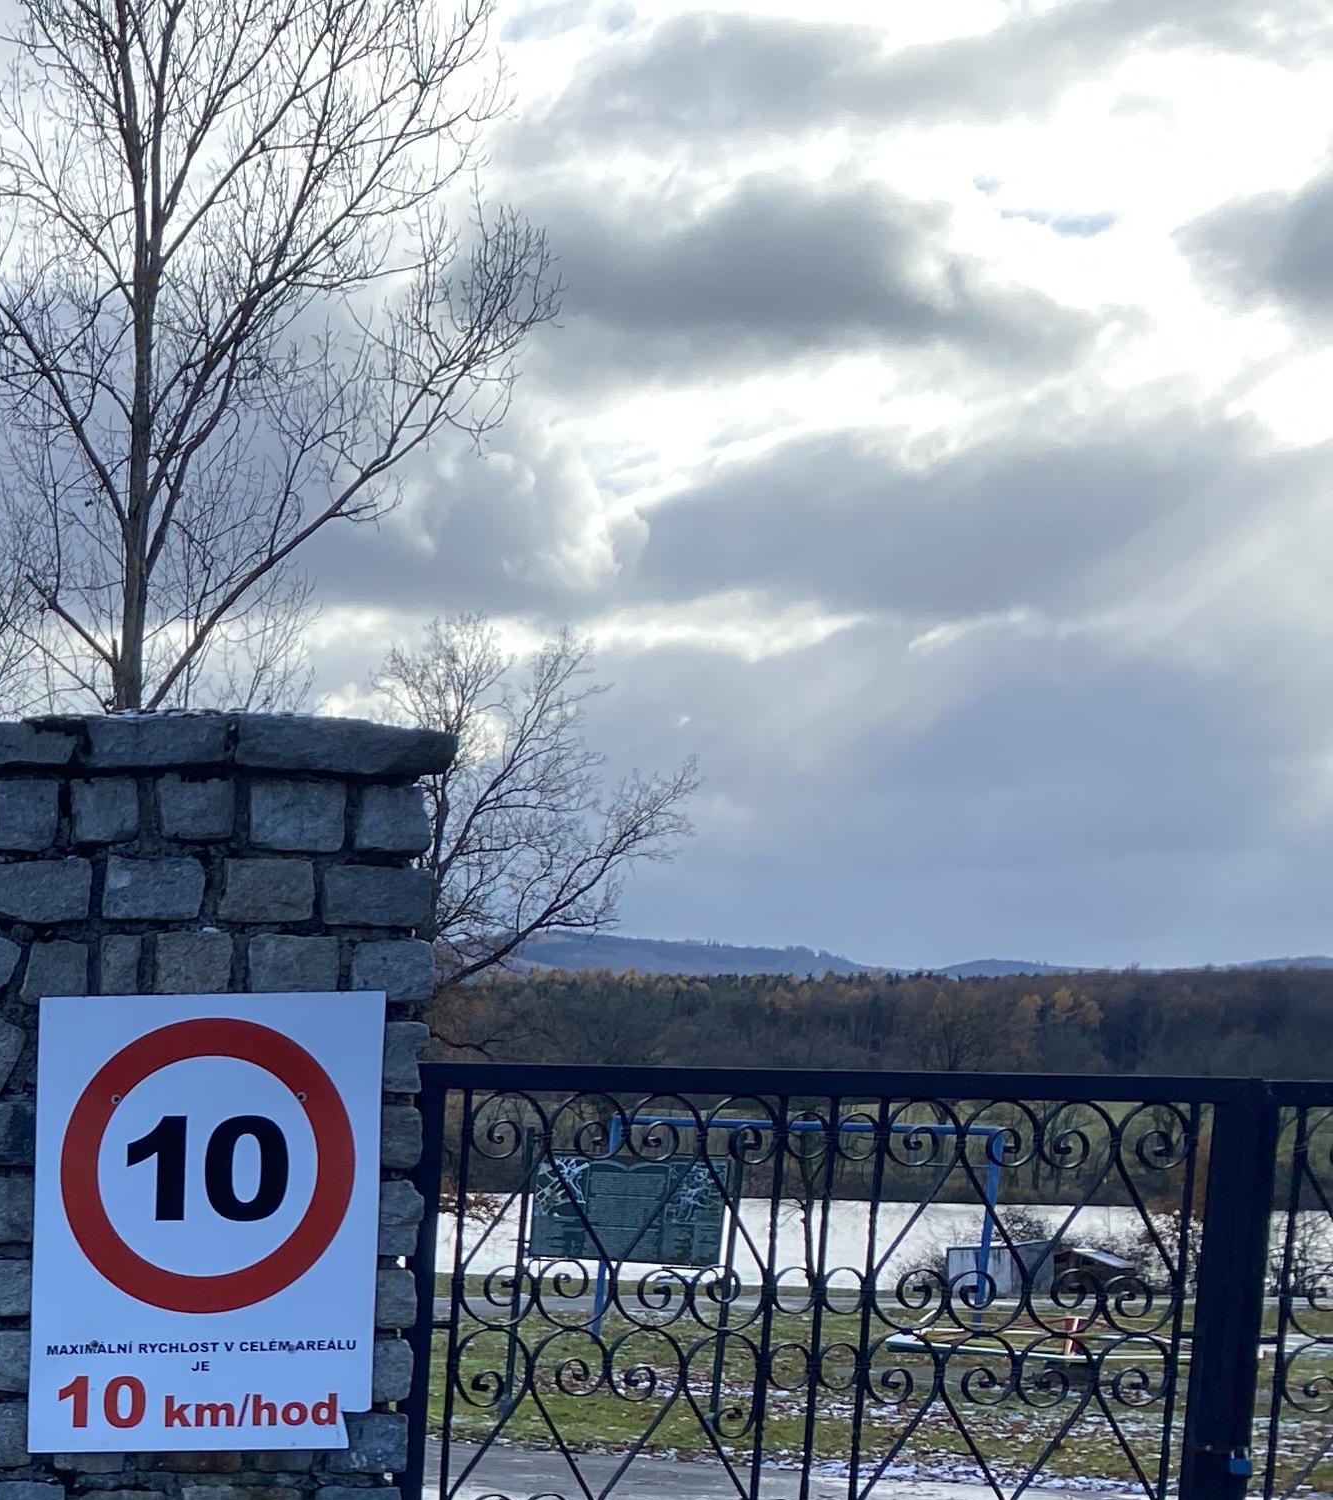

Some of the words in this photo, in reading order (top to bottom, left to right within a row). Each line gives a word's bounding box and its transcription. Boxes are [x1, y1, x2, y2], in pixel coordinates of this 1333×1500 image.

[126, 1114, 289, 1222] 10
[46, 1340, 133, 1356] MAXIMÁLNÍ
[138, 1341, 220, 1354] RYCHLOST
[224, 1341, 235, 1353] V
[239, 1338, 290, 1353] CELÉM
[295, 1338, 357, 1351] AREÁLU
[191, 1360, 211, 1372] JE
[57, 1375, 147, 1429] 10
[164, 1392, 339, 1428] km/hod
